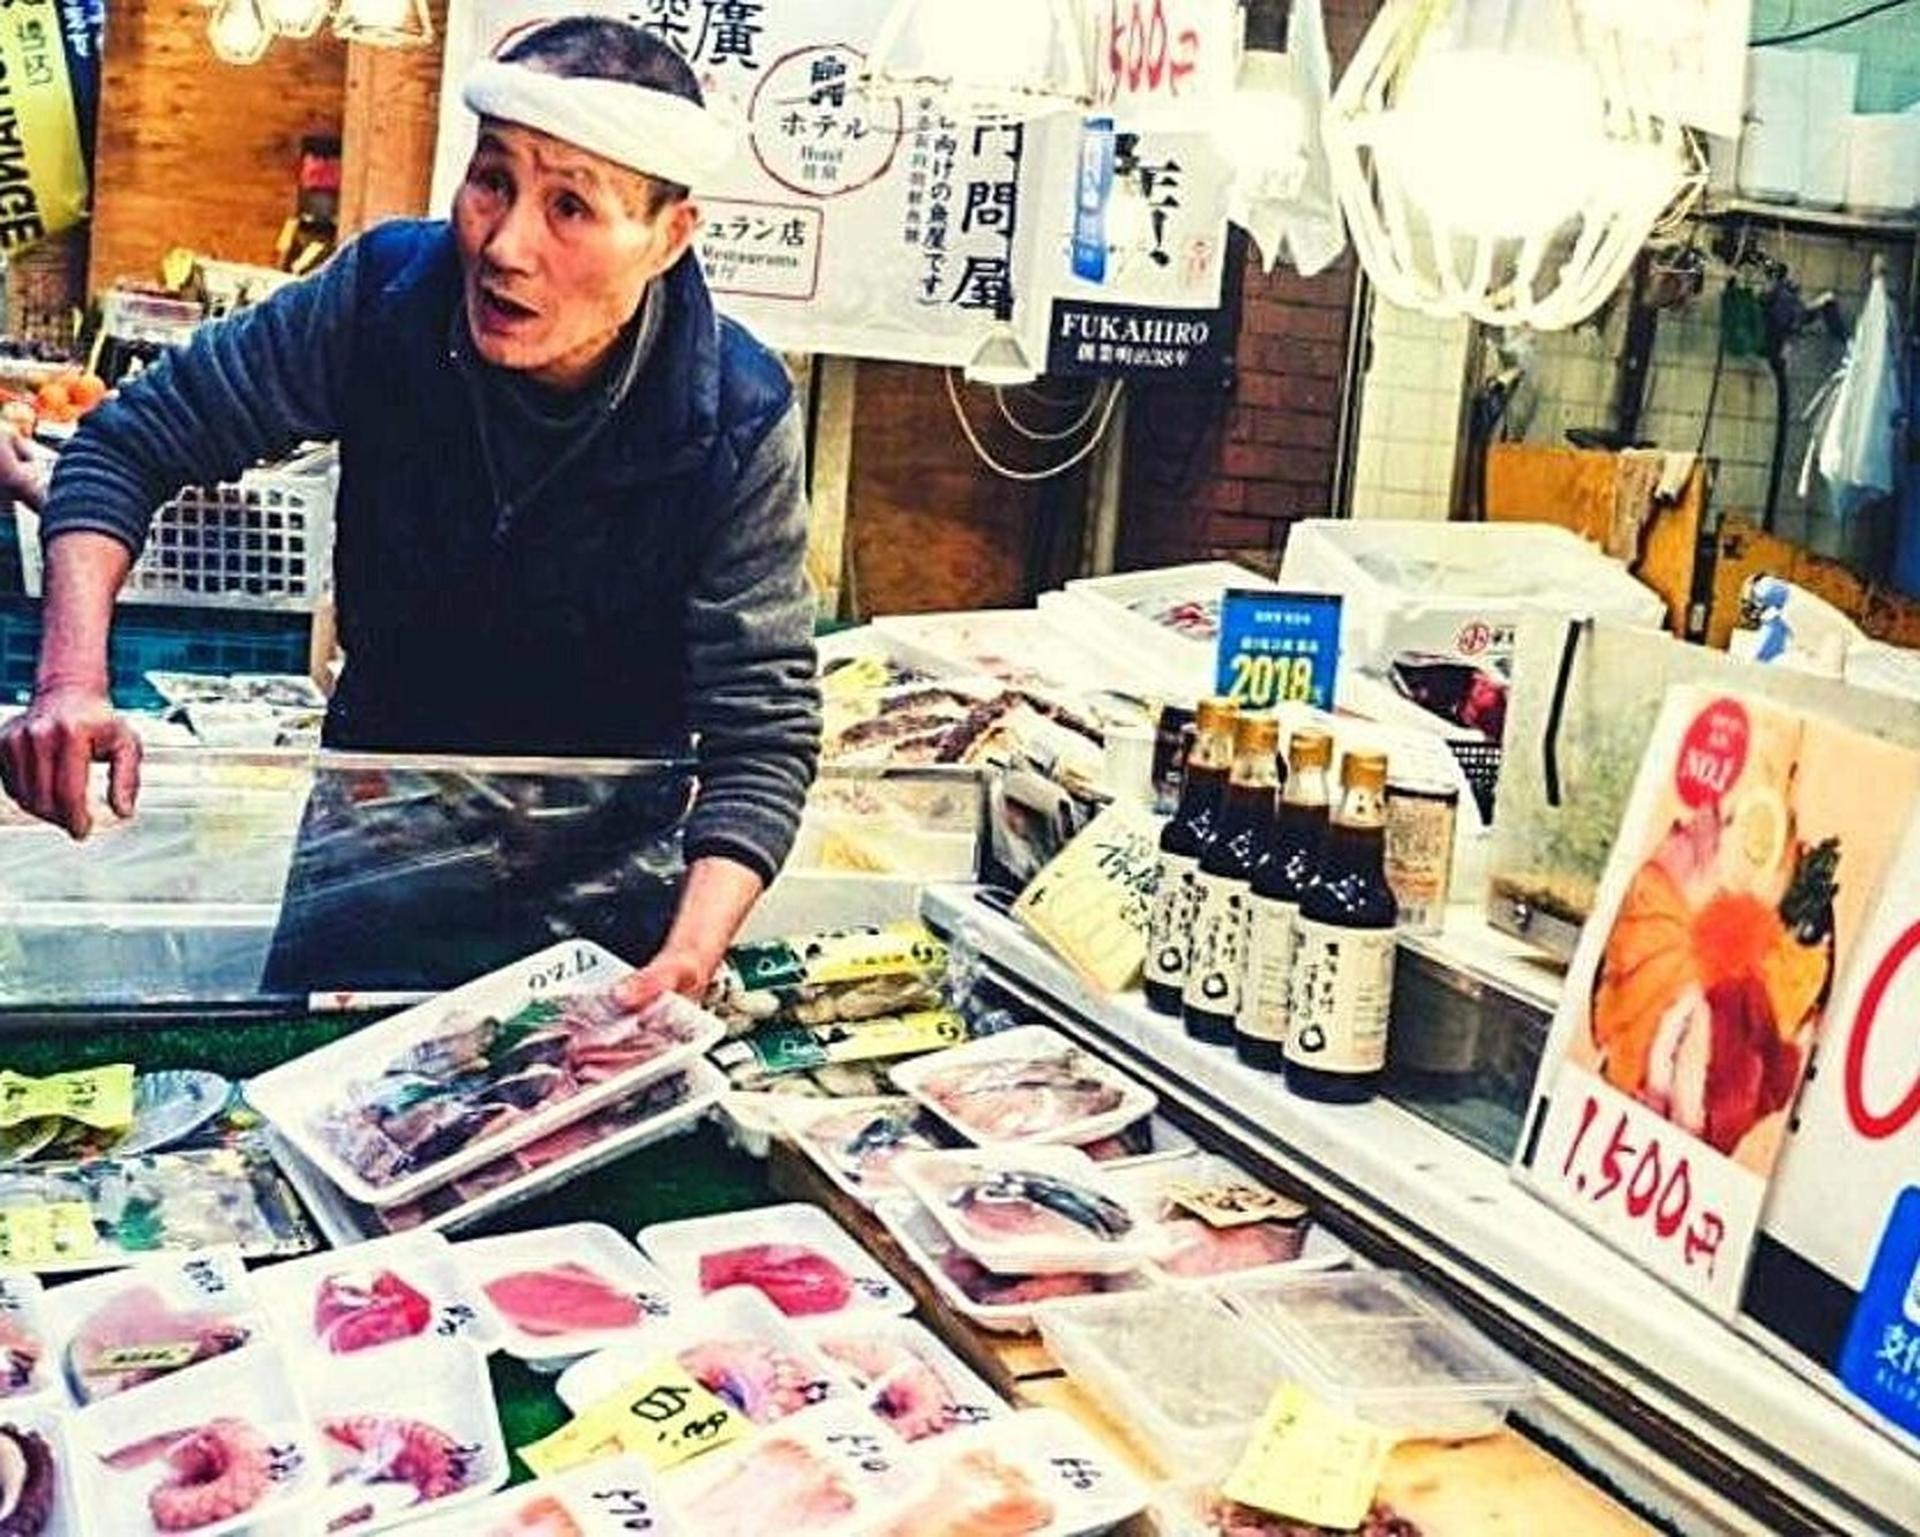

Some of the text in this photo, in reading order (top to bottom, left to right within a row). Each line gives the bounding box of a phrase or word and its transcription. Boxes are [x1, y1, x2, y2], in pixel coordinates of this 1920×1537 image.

[781, 112, 869, 139] ホテル
[1061, 312, 1210, 345] FUKAHIRO
